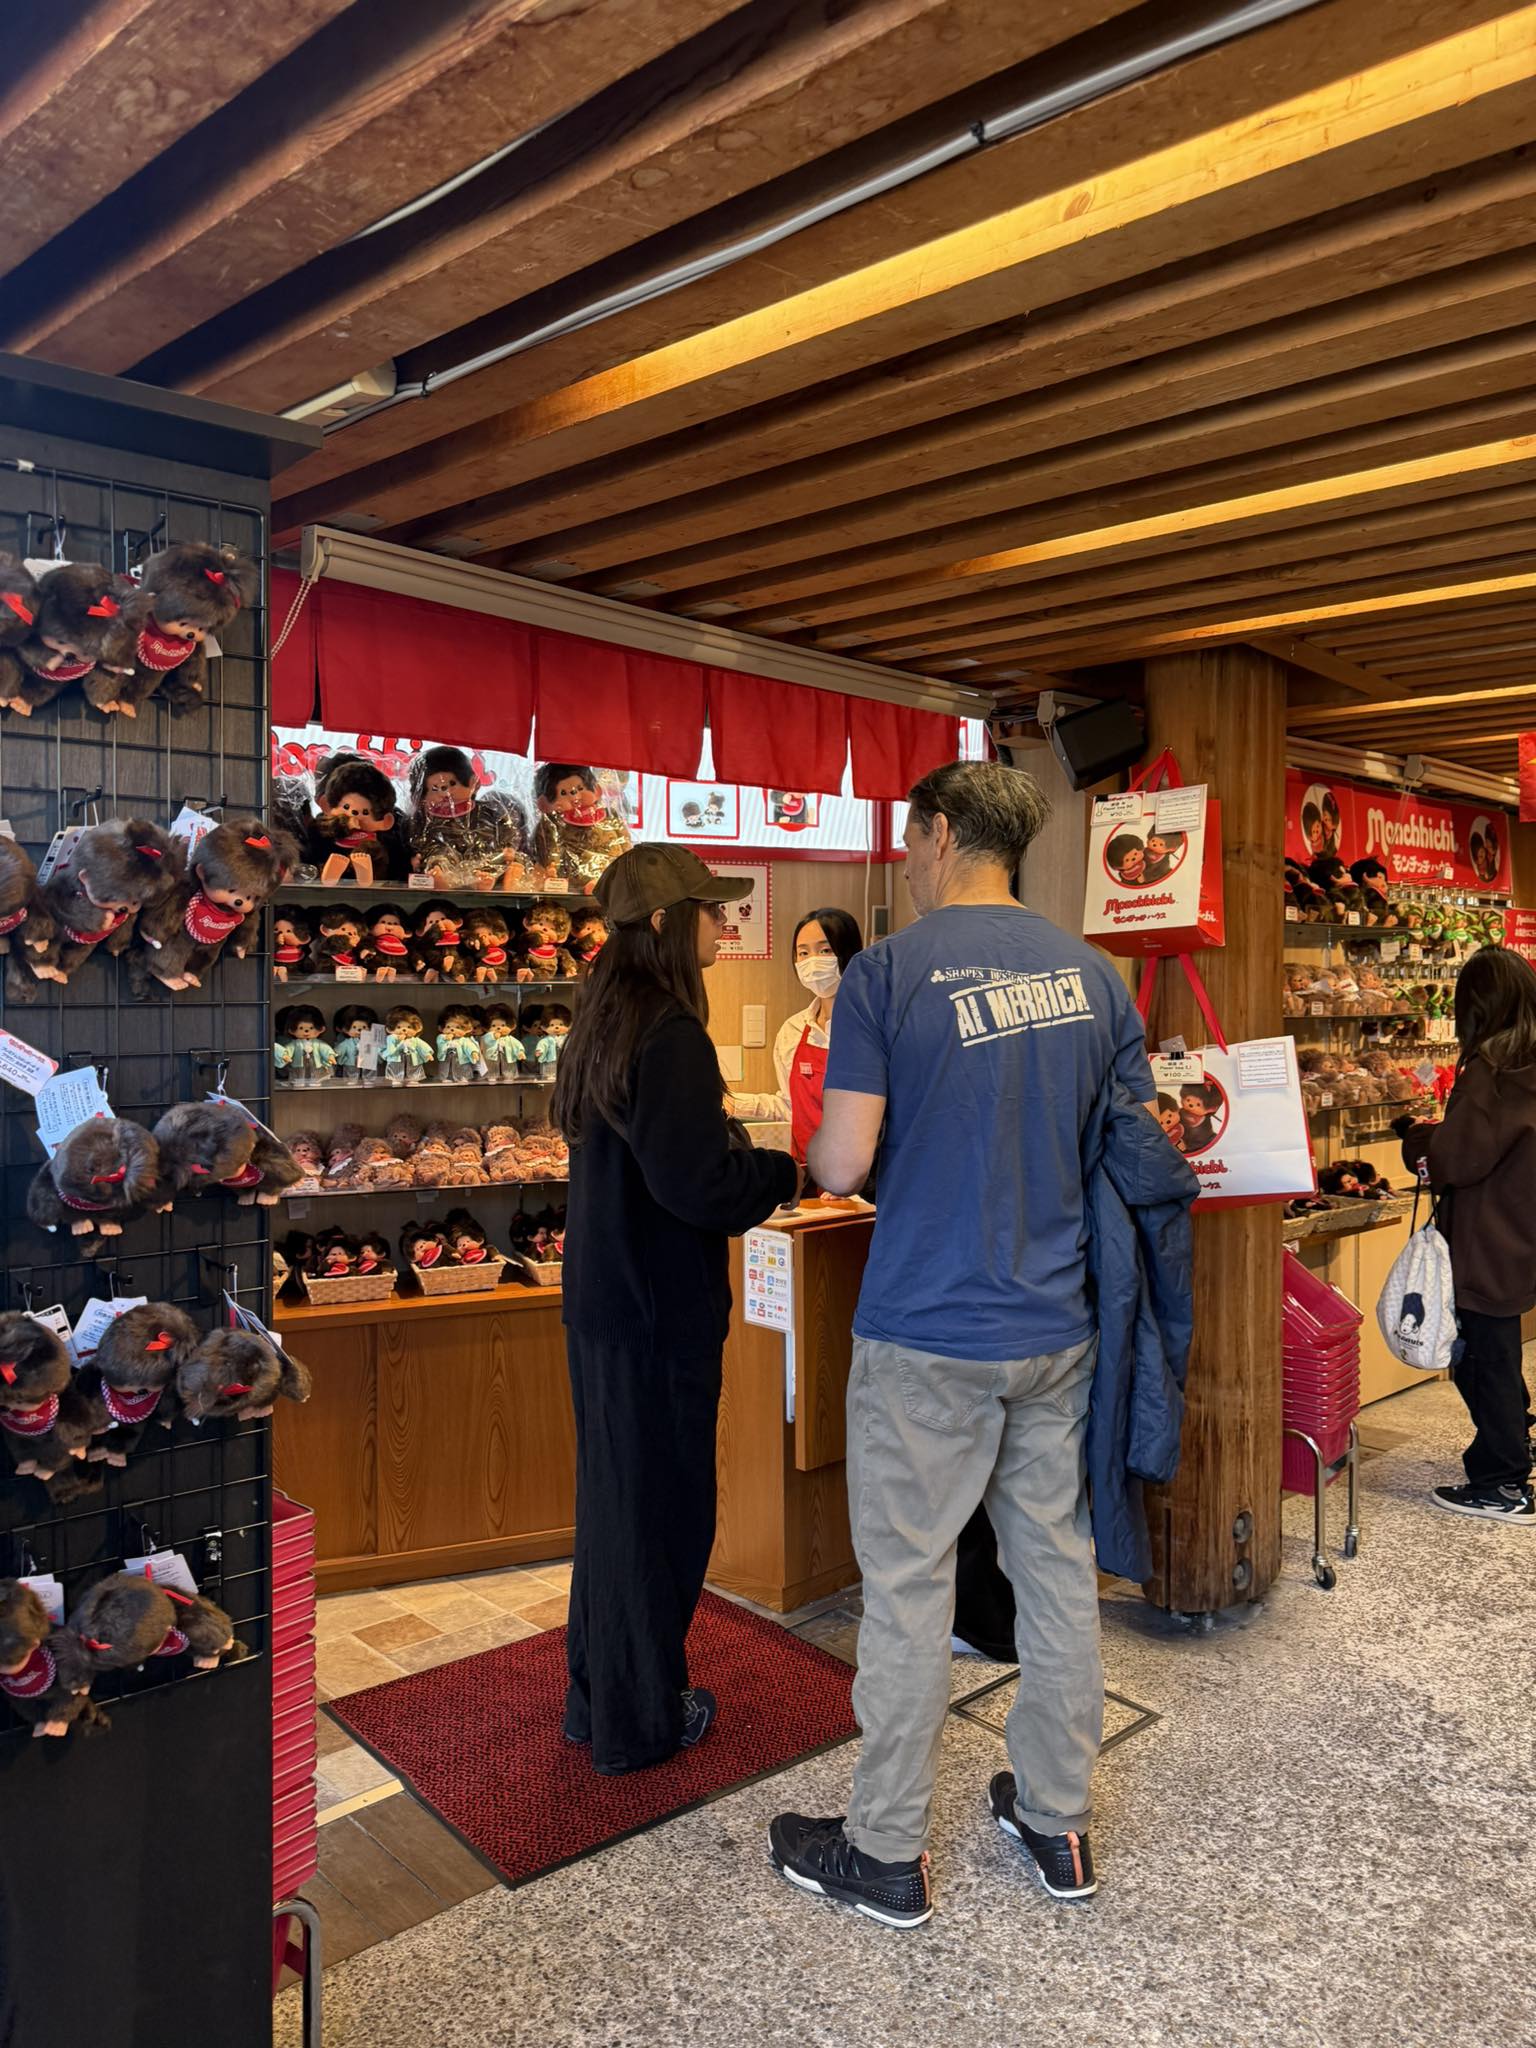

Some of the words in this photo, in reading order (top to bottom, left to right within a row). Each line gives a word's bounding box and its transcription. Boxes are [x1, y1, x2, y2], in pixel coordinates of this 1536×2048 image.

[1366, 808, 1458, 856] Monchhichi
[1392, 854, 1451, 874] モンチッチハウ
[1103, 893, 1175, 916] Monchhichi
[945, 969, 984, 979] SHAPES
[954, 995, 988, 1039] AL
